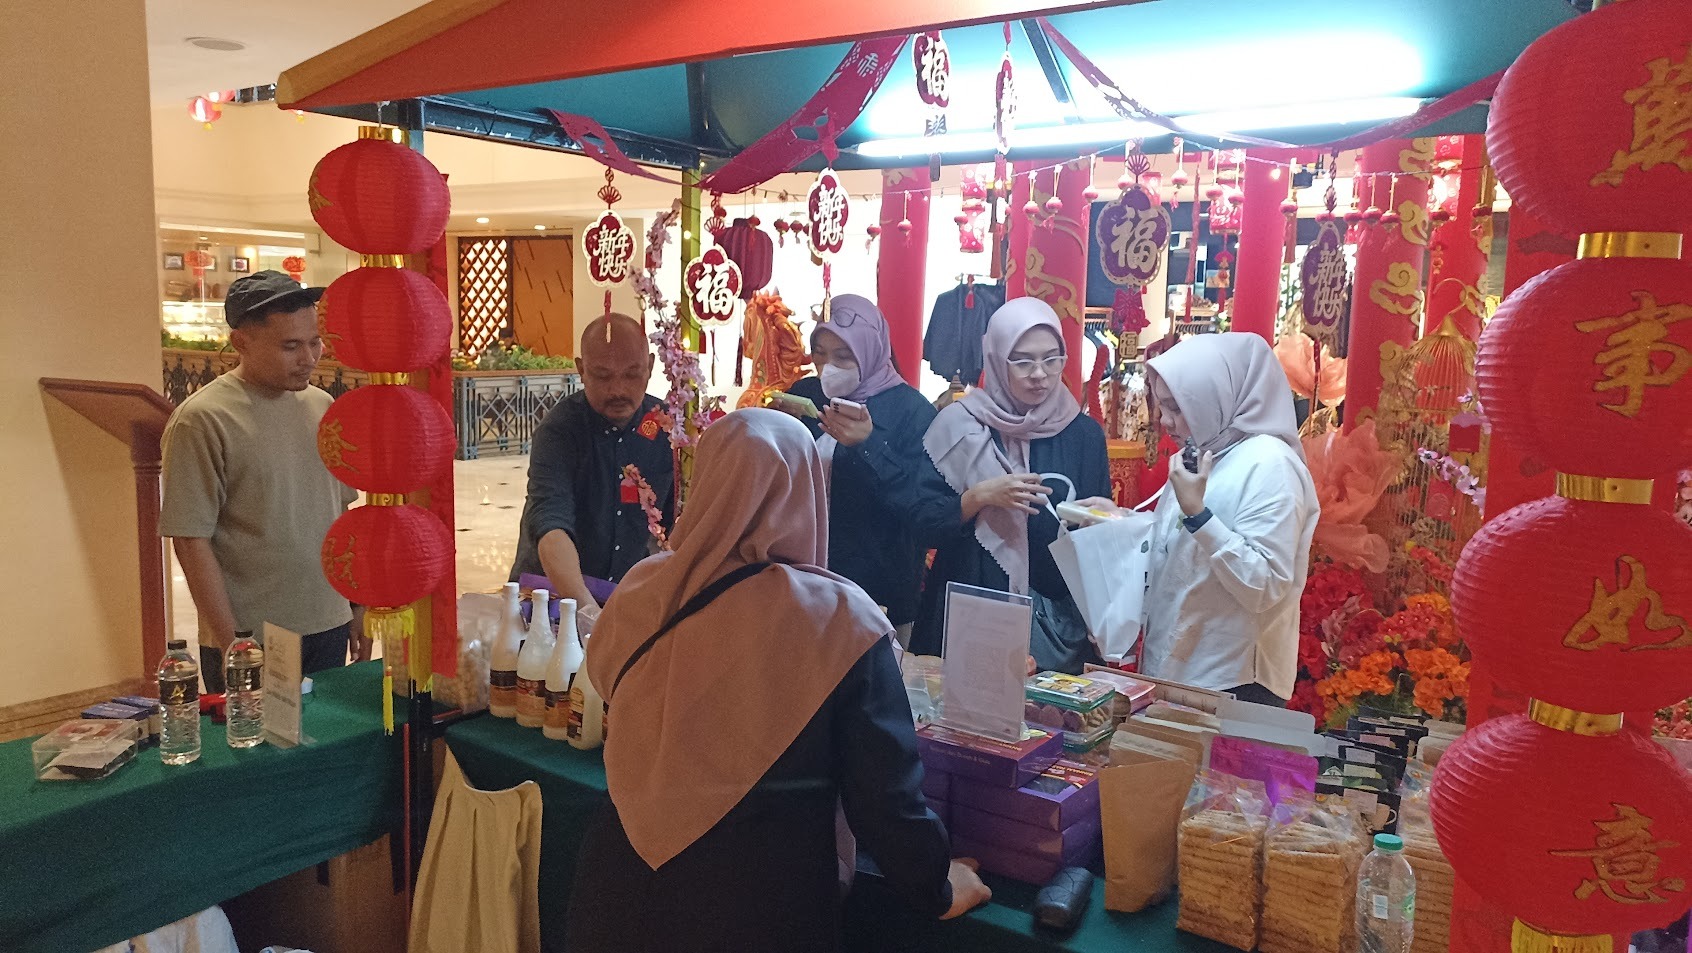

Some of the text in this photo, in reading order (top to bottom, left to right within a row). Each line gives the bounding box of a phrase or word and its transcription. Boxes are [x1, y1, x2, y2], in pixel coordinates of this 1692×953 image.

[921, 36, 950, 101] 福
[1111, 205, 1160, 273] 福
[695, 263, 733, 316] 福
[1546, 801, 1686, 904] 意
